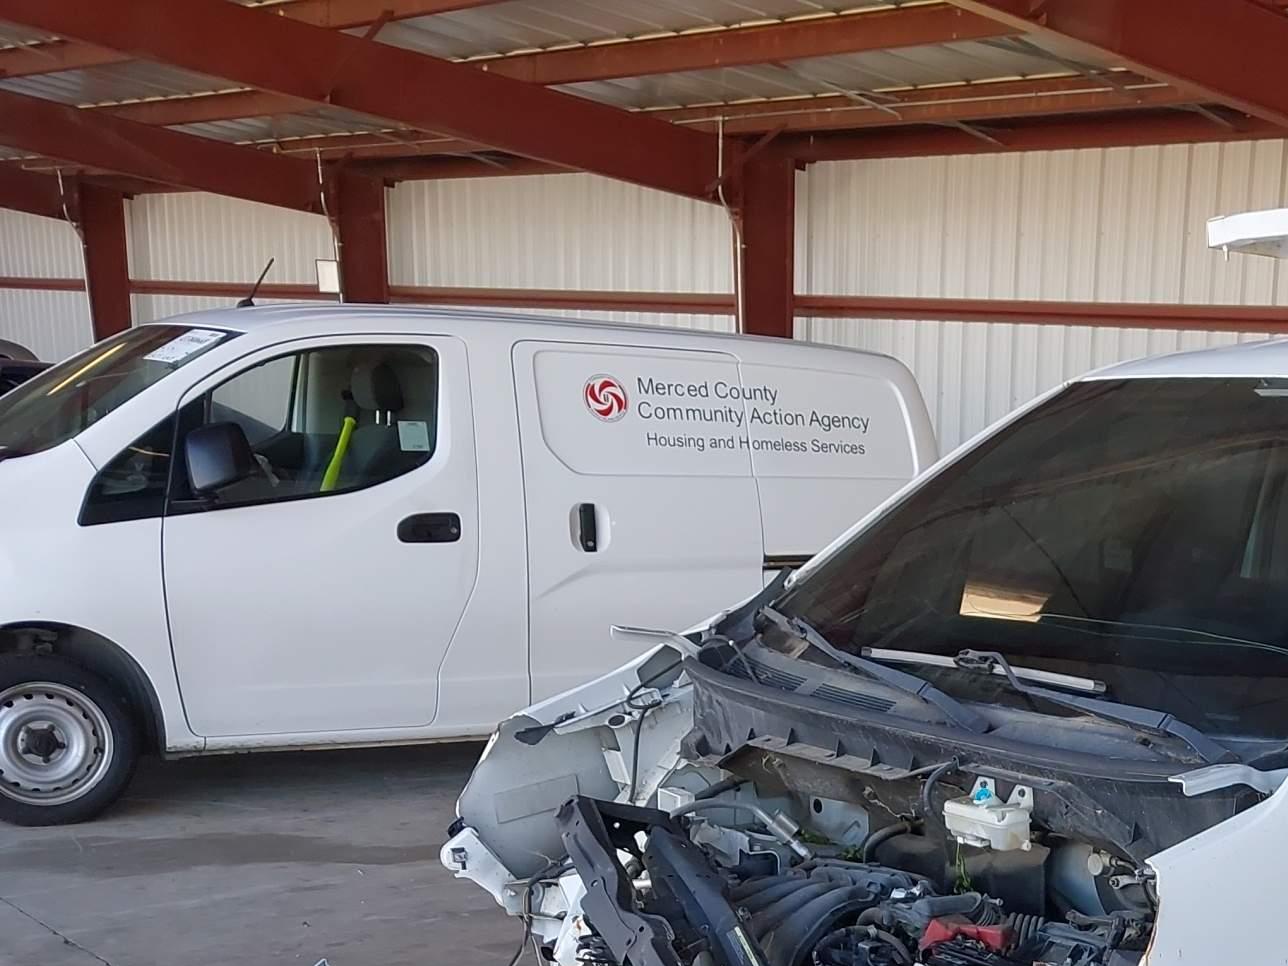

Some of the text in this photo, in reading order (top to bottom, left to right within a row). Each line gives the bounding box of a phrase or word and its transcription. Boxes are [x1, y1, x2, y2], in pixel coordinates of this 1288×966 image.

[637, 377, 778, 405] Merced County
[637, 402, 870, 433] Community Action Agency
[647, 432, 866, 455] Housing and Homeless Services
